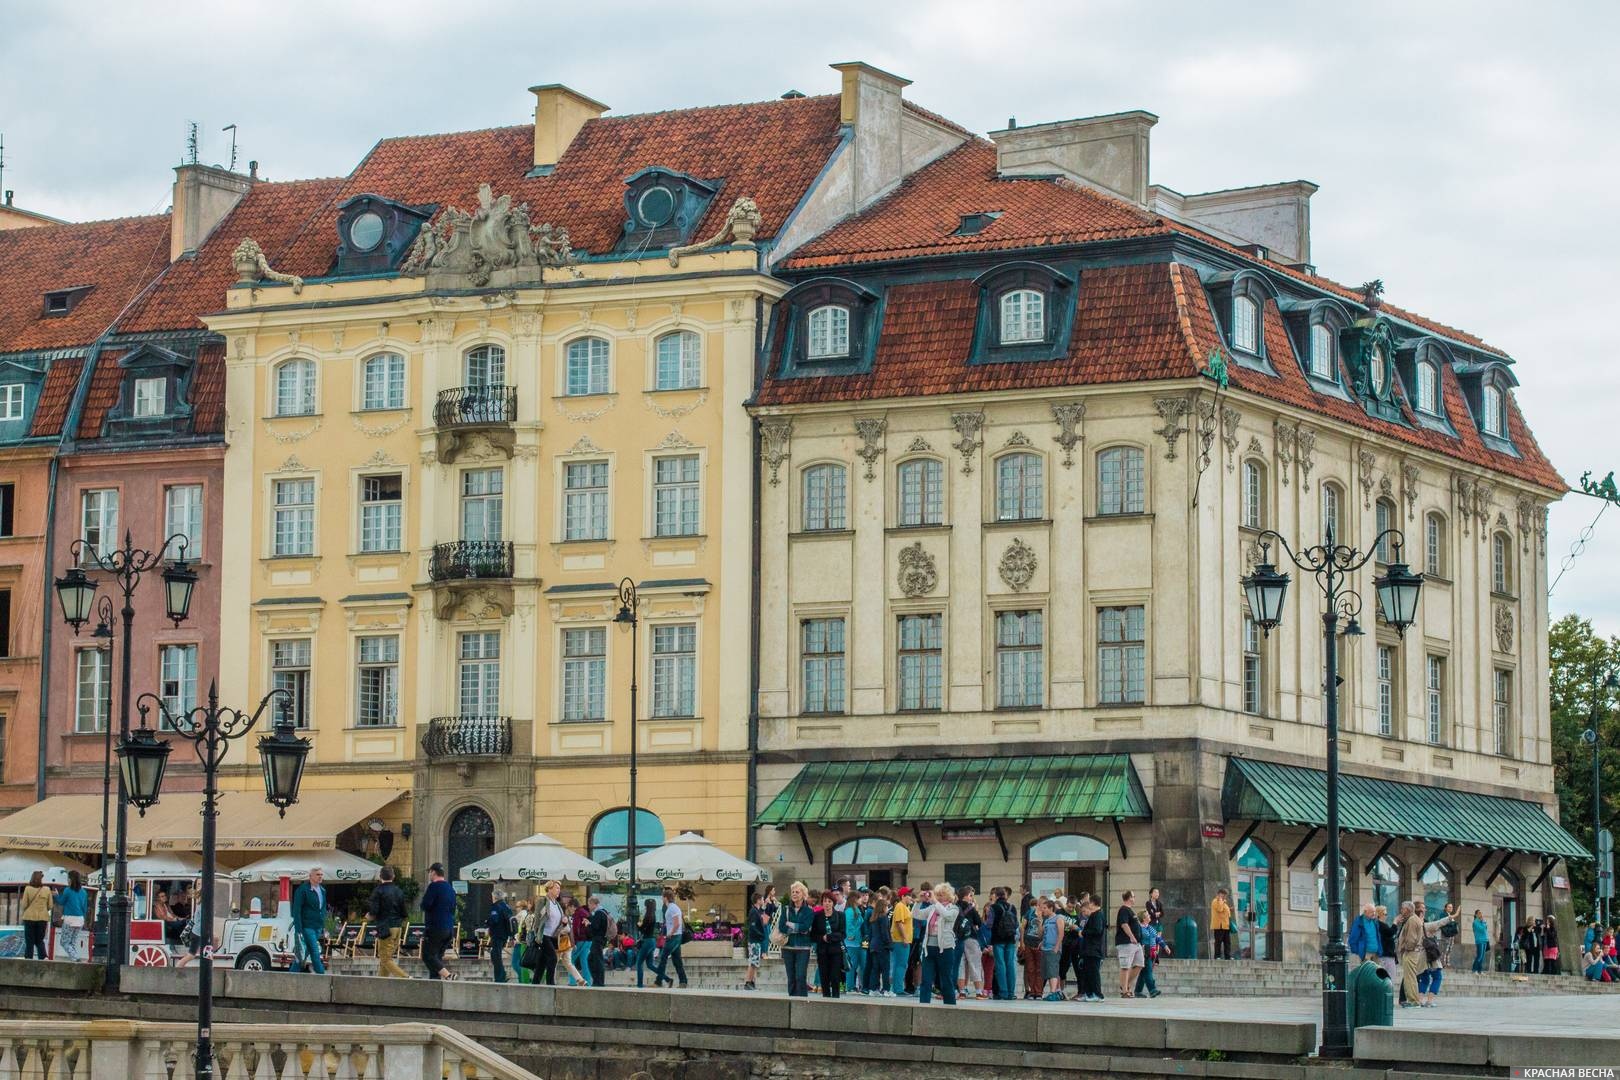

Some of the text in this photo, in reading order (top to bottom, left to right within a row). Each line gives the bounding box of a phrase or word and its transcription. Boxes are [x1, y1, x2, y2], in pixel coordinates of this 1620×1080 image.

[518, 868, 547, 880] Carlsberg
[577, 869, 600, 881] Carlsberg
[655, 868, 684, 880] Carlsberg
[716, 869, 743, 881] Carlsberg
